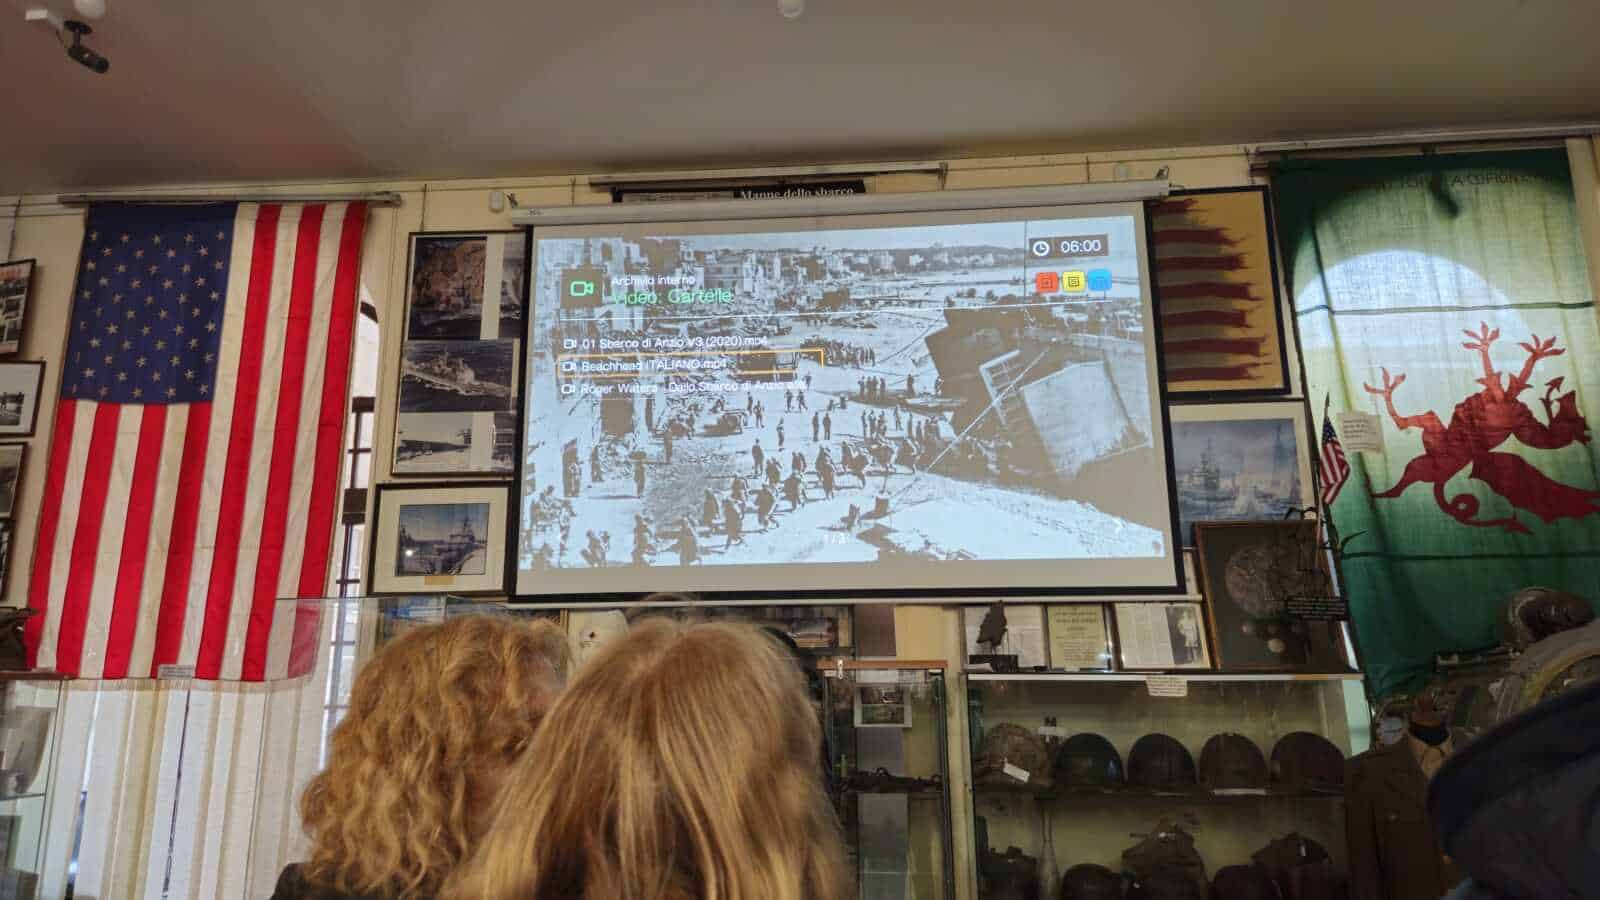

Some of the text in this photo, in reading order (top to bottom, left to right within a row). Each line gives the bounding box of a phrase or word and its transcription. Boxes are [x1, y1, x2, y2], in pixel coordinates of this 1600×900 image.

[1060, 239, 1102, 254] 06:00
[668, 287, 733, 304] Cartelle
[582, 338, 596, 349] 01
[641, 336, 652, 348] di
